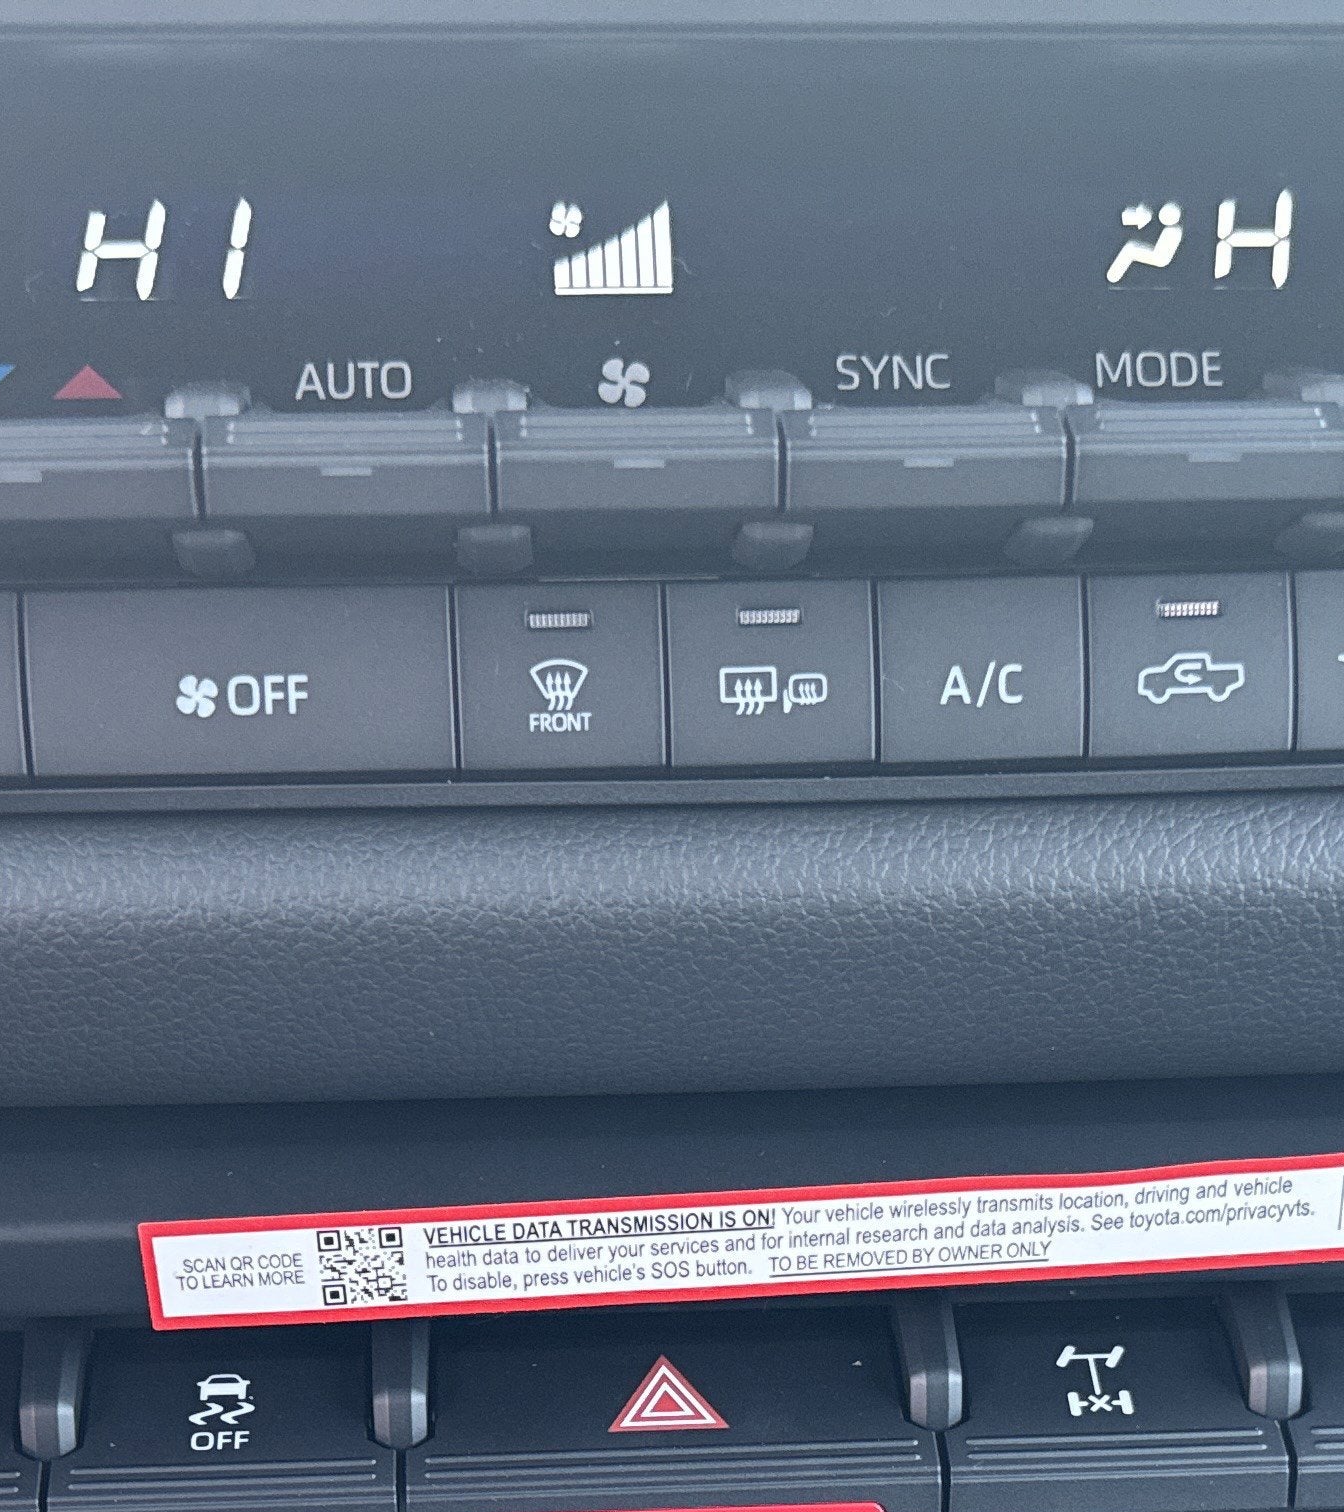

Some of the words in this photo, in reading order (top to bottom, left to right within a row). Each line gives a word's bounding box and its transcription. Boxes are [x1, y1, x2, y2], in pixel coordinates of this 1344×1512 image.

[295, 361, 412, 401] AUTO
[837, 354, 951, 391] SYNC
[1095, 353, 1223, 389] MODE
[226, 675, 308, 718] OFF
[940, 664, 1023, 708] A/C
[529, 712, 592, 733] FRONT
[423, 1224, 506, 1244] VEHICLE
[513, 1220, 563, 1240] DATA
[567, 1212, 713, 1237] TRANSMISSION
[720, 1211, 736, 1227] IS
[743, 1208, 776, 1226] ON!
[782, 1206, 821, 1225] Your
[825, 1202, 883, 1222] vehicle
[889, 1196, 971, 1219] wirelessly
[976, 1193, 1053, 1213] transmits
[1059, 1191, 1129, 1209] location,
[1134, 1186, 1190, 1205] driving
[1196, 1180, 1228, 1199] and
[1234, 1176, 1293, 1196] vehicle
[426, 1249, 477, 1269] health
[483, 1247, 519, 1267] data
[526, 1248, 541, 1263] to
[548, 1243, 604, 1262] deliver
[608, 1241, 645, 1264] your
[650, 1235, 718, 1256] services
[725, 1234, 755, 1251] and
[761, 1231, 783, 1250] for
[789, 1228, 849, 1248] internal
[856, 1224, 928, 1244] research
[934, 1220, 965, 1239] and
[970, 1219, 1006, 1238] data
[1012, 1215, 1085, 1237] analysis.
[1091, 1213, 1124, 1231] See
[1130, 1199, 1315, 1231] toyota.com/privacyvts.
[176, 1275, 198, 1291] TO
[203, 1273, 254, 1289] LEARN
[256, 1270, 305, 1286] MORE
[183, 1258, 226, 1273] SCAN
[231, 1256, 254, 1271] QR
[258, 1253, 303, 1269] CODE
[426, 1275, 447, 1292] To
[453, 1271, 517, 1291] disable,
[523, 1271, 568, 1290] press
[573, 1263, 645, 1283] vehicle's
[651, 1261, 690, 1279] SOS
[696, 1258, 753, 1277] button.
[770, 1256, 791, 1273] TO
[797, 1254, 818, 1271] BE
[823, 1249, 907, 1269] REMOVED
[912, 1246, 935, 1263] BY
[939, 1243, 1002, 1262] OWNER
[1007, 1240, 1052, 1259] ONLY
[189, 1430, 250, 1452] OFF
